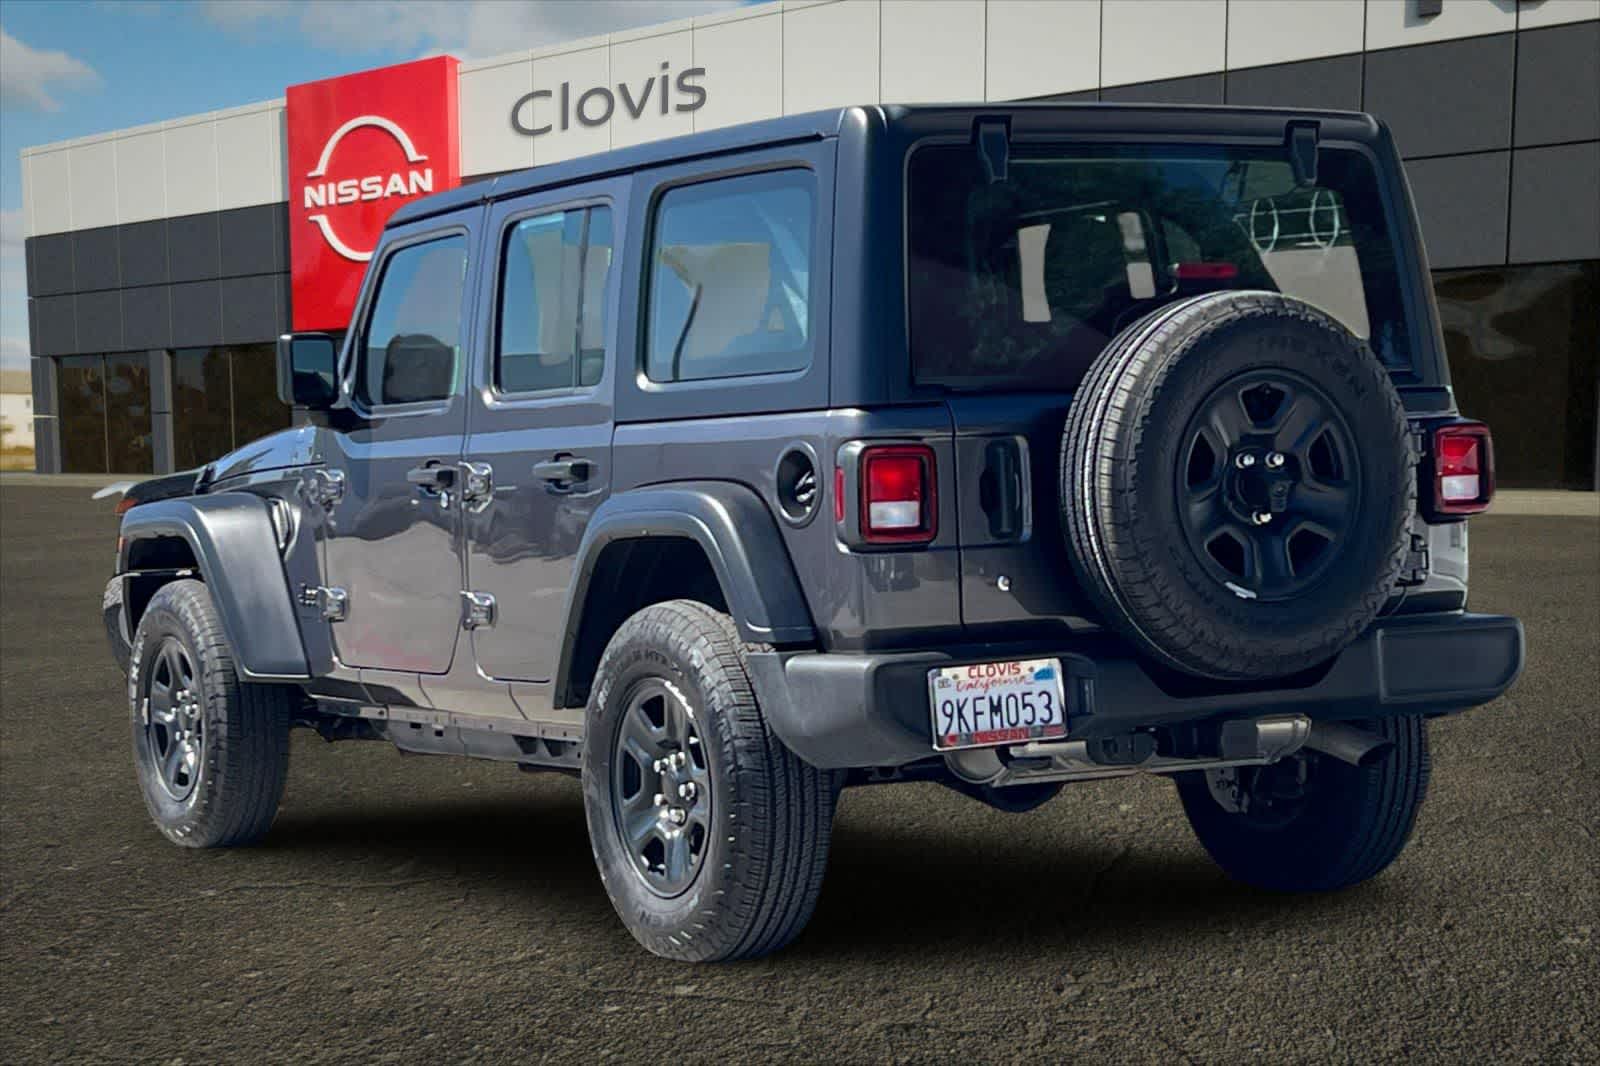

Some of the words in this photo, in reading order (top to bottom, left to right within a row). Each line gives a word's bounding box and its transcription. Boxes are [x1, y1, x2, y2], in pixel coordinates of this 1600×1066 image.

[511, 61, 707, 136] Clovis
[304, 168, 434, 208] NISSAN
[968, 664, 1021, 679] CLOVIS
[942, 691, 1053, 736] 9KFM053
